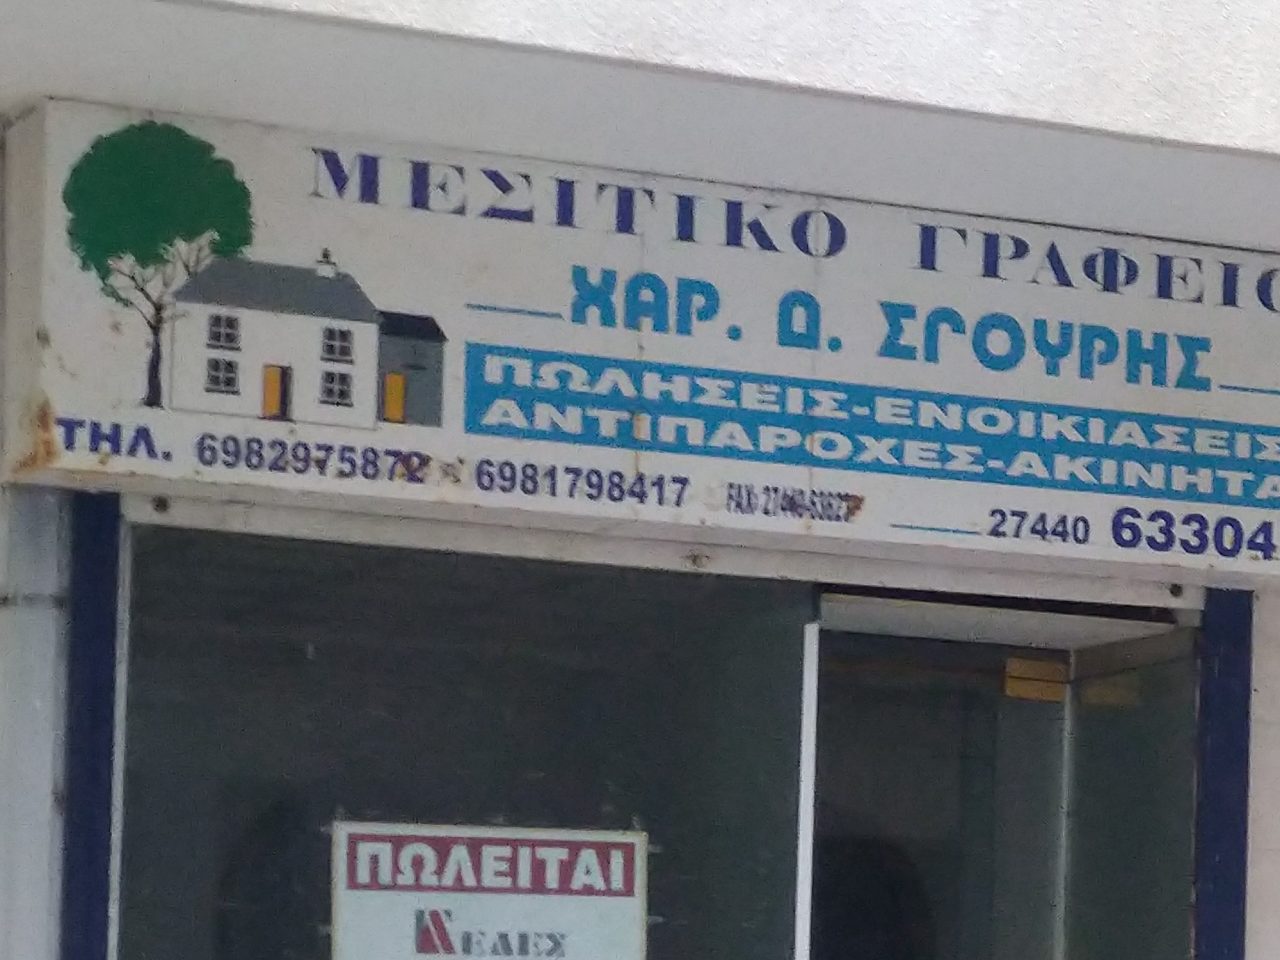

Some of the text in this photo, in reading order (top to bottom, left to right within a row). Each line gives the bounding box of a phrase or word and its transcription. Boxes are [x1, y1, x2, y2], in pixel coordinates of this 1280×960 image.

[310, 146, 848, 259] ΜΕΣΙΤΙΚΟ
[570, 264, 1212, 392] ΧΑΡ. Δ. ΣΓΟΥΡΗΣ
[56, 416, 173, 462] ΤΗΛ.
[476, 459, 690, 508] 6981798417
[987, 506, 1277, 562] 27440 63304
[356, 841, 625, 892] ΠΩΛΕΙΤΑΙ
